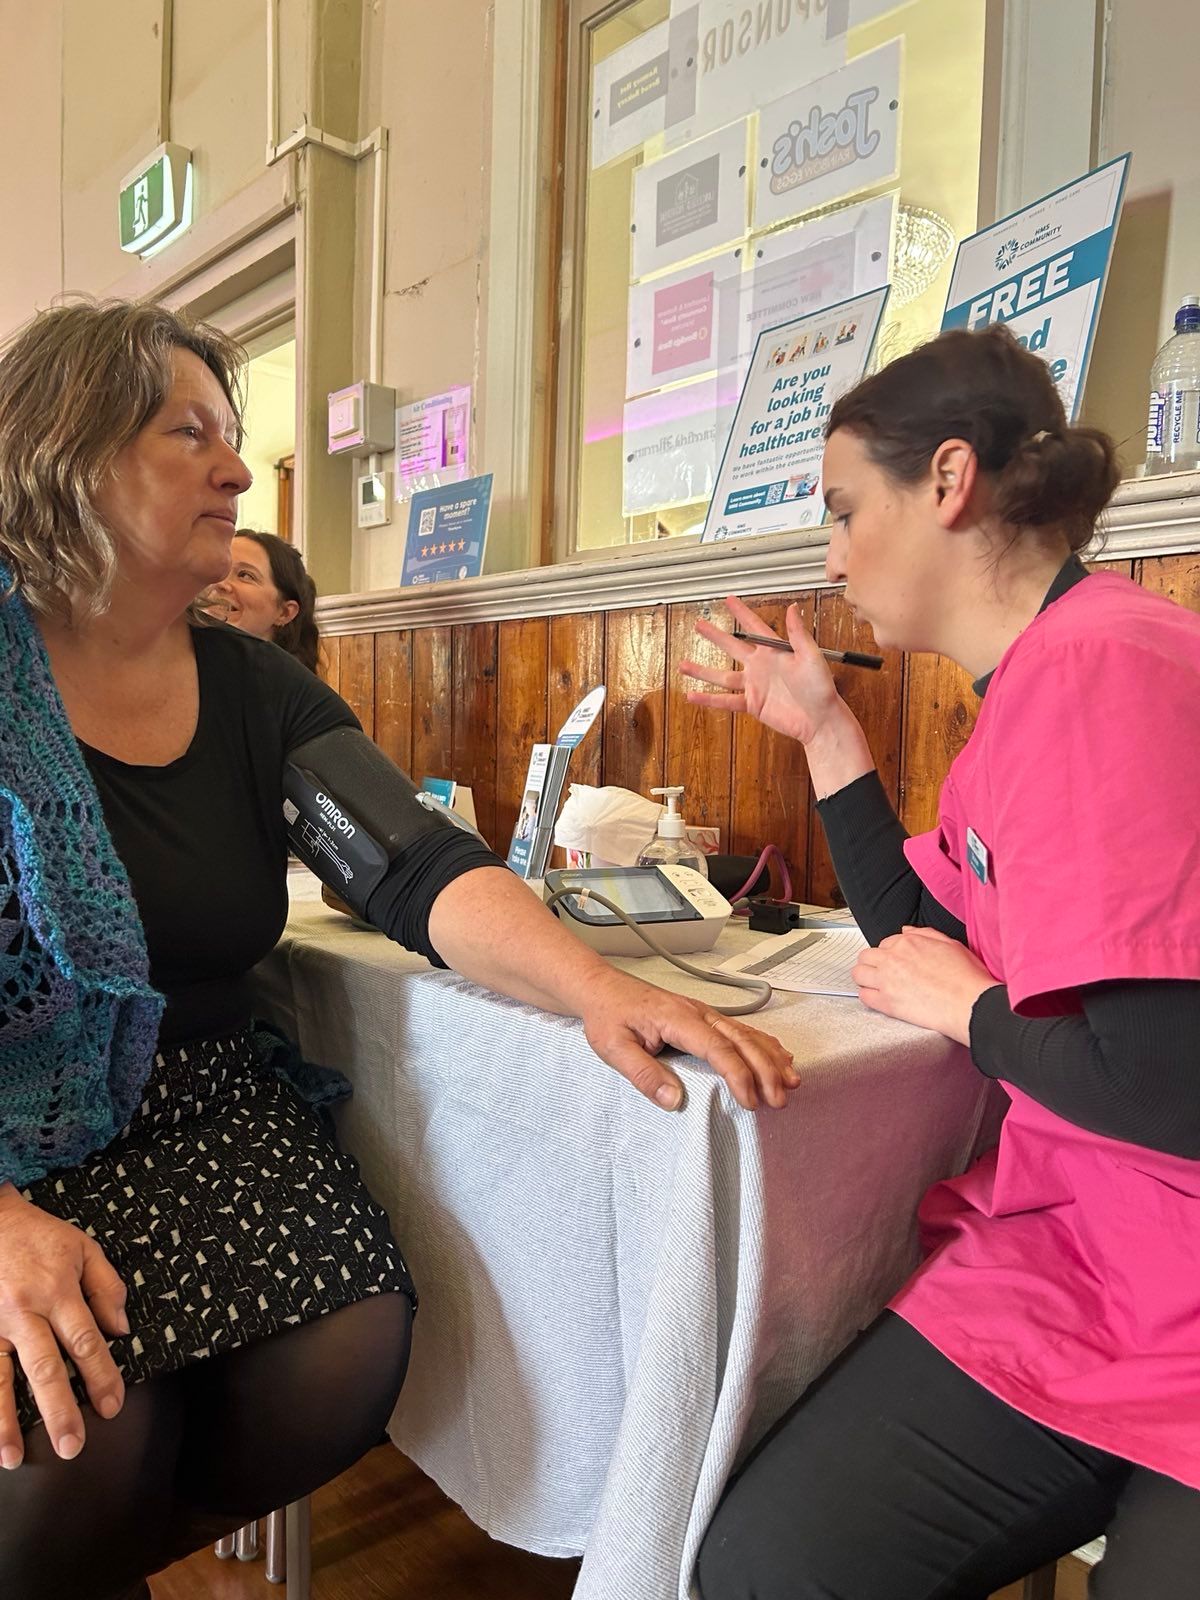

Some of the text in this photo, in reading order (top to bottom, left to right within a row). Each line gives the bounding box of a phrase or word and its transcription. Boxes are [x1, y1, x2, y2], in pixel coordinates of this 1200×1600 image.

[1020, 225, 1063, 251] COMMUNITY
[1034, 223, 1051, 236] HMS
[967, 250, 1074, 332] FREE
[772, 364, 831, 393] Are you
[767, 383, 826, 412] looking
[750, 402, 831, 437] for a job in
[1146, 390, 1166, 453] pump
[1172, 389, 1184, 444] RECYCLE ME
[740, 471, 754, 479] work
[755, 465, 775, 475] within
[787, 453, 823, 466] community
[742, 462, 756, 470] have
[757, 454, 784, 466] fantastic
[784, 445, 825, 459] opportuniti
[439, 503, 454, 513] Have
[460, 498, 478, 509] spare
[443, 507, 471, 520] moment?
[315, 792, 356, 840] OMRON
[511, 854, 520, 864] take
[514, 845, 527, 856] Please
